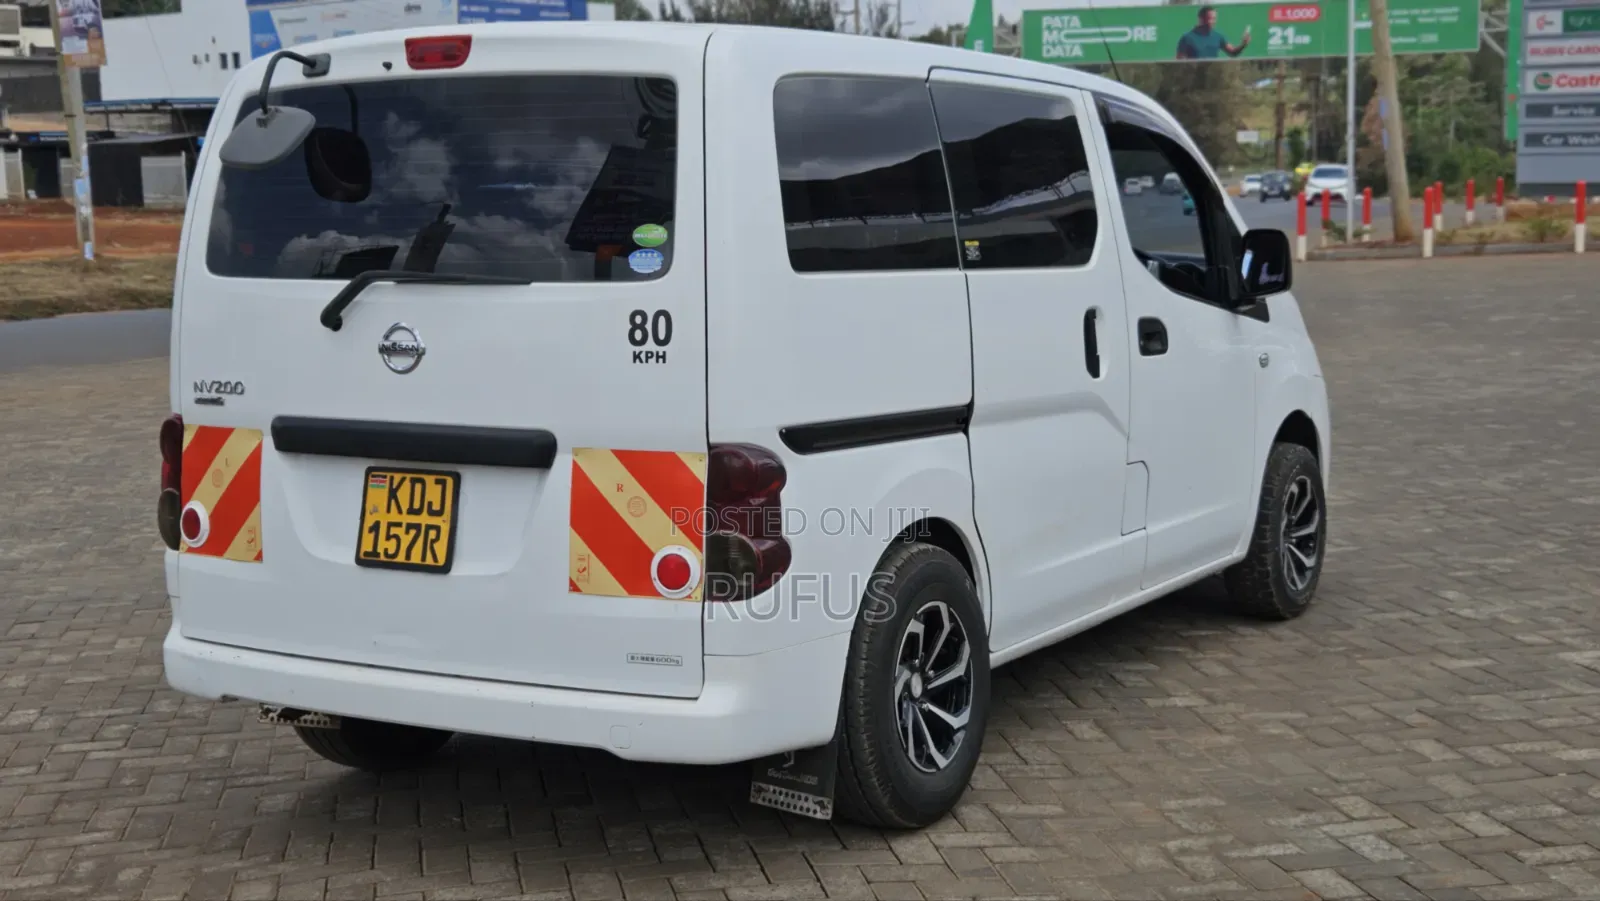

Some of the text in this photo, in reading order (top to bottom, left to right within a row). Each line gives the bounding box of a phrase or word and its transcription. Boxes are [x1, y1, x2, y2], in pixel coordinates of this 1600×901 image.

[1042, 15, 1081, 28] PATA
[1042, 44, 1083, 57] DATA
[1542, 134, 1564, 146] Car
[628, 309, 673, 347] 80
[380, 342, 419, 353] NISSAN
[632, 350, 667, 364] KPH
[193, 379, 246, 396] NV200
[616, 483, 624, 493] R
[386, 475, 447, 517] KDJ
[362, 520, 442, 564] 157R
